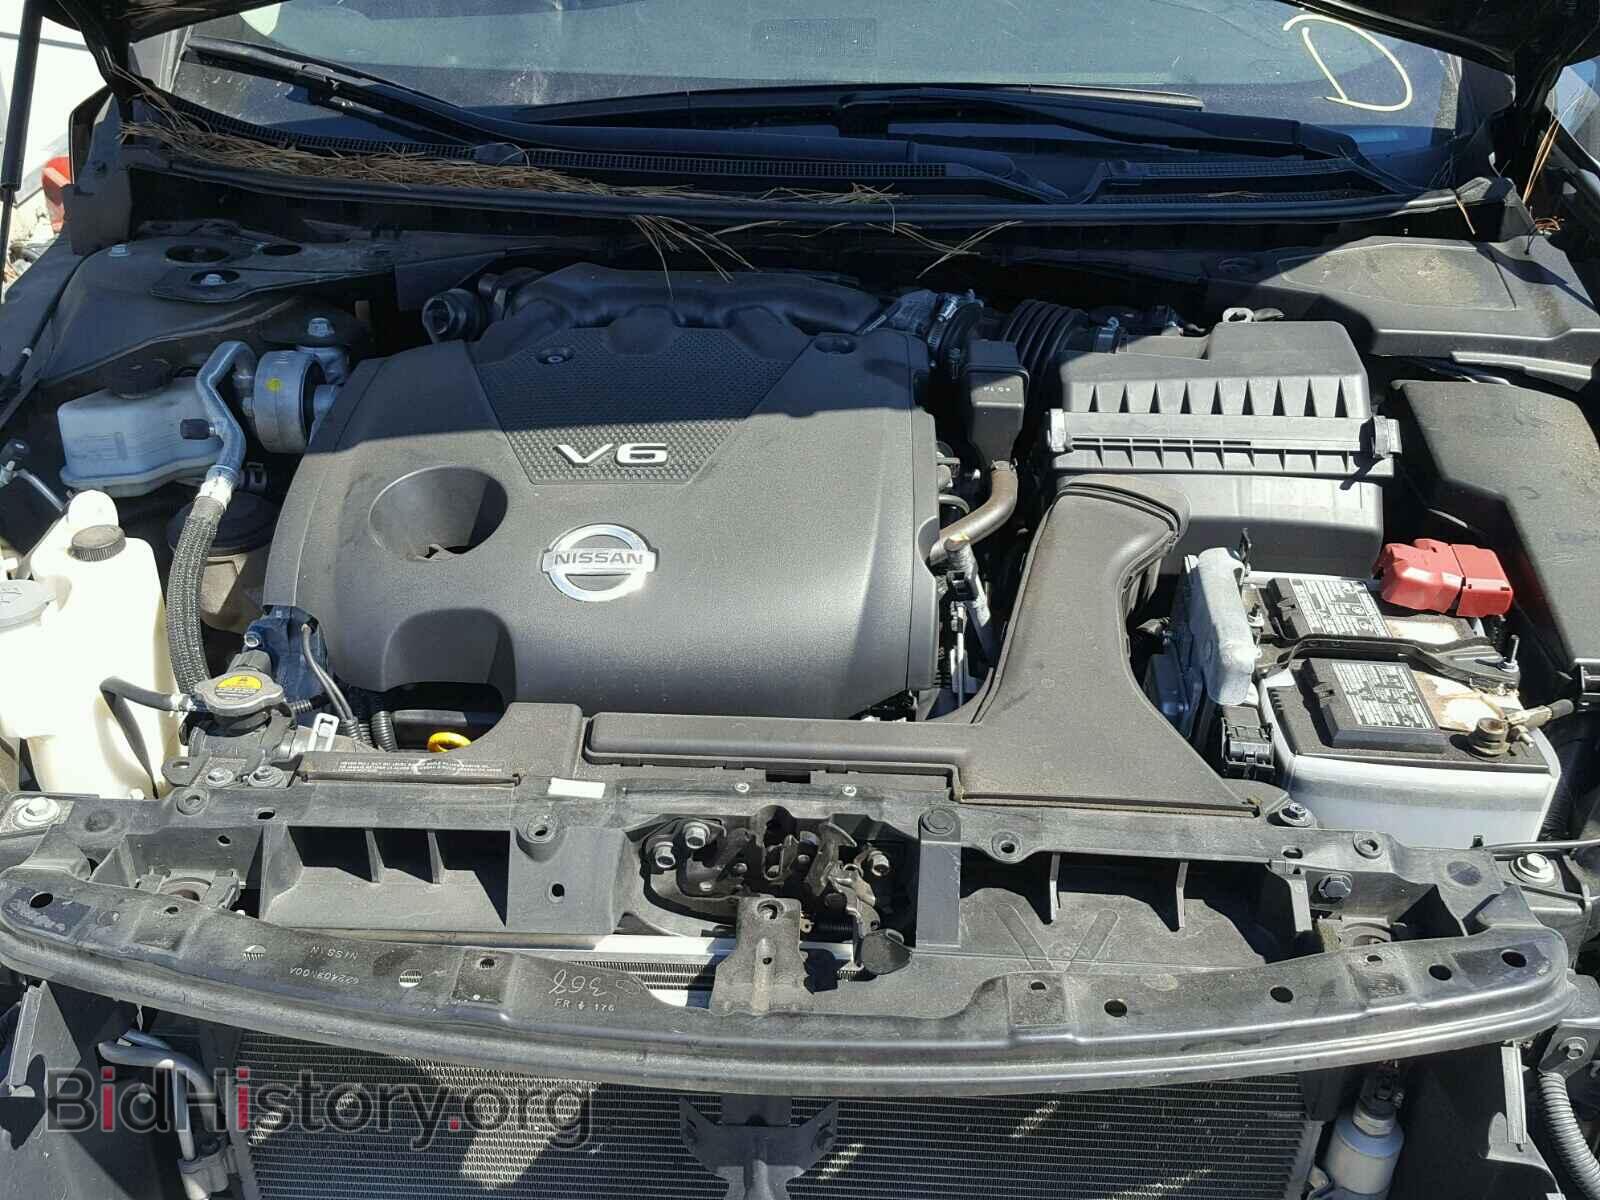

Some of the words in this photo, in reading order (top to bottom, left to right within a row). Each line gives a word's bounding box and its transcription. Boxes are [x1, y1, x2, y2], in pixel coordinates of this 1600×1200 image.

[1283, 14, 1412, 112] D
[554, 442, 668, 468] V6
[554, 552, 643, 565] NISSAN
